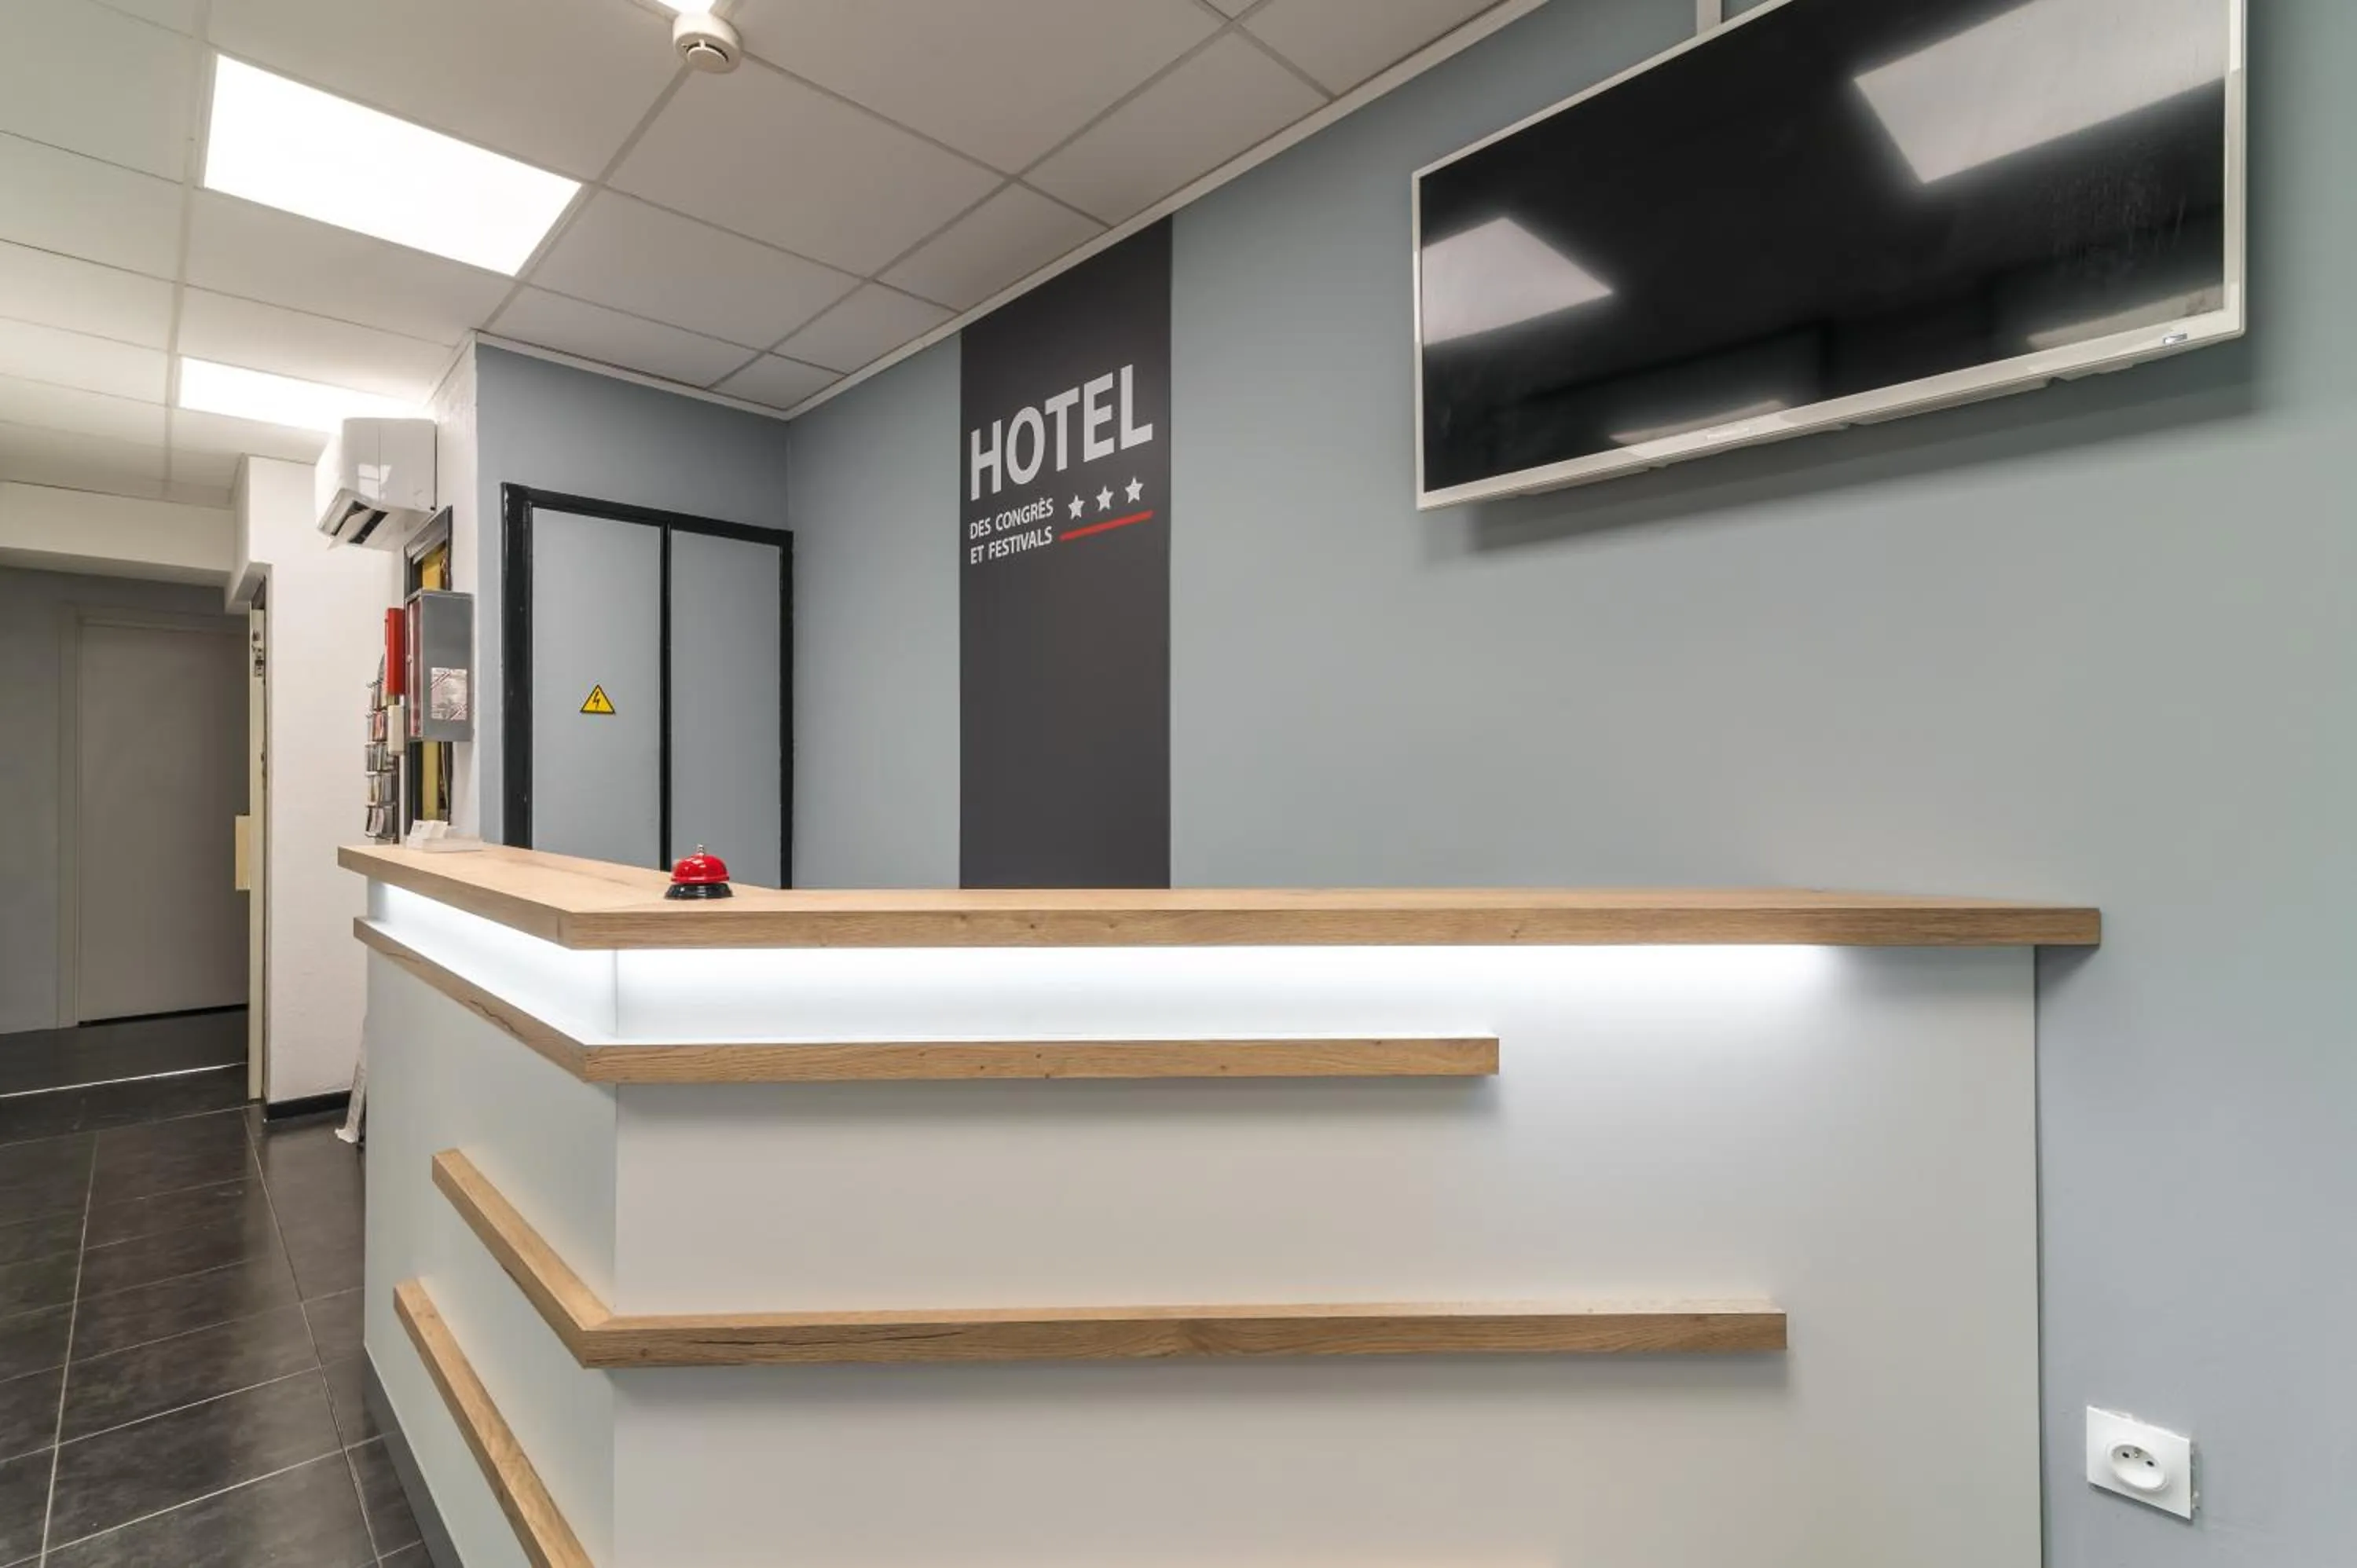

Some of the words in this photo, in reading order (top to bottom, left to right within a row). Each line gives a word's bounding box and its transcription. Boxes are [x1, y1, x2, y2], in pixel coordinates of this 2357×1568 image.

[970, 364, 1153, 501] HOTEL
[970, 518, 991, 539] DES
[995, 497, 1054, 531] CONGRÈS
[970, 545, 984, 565] ET
[988, 526, 1053, 560] FESTIVALS
